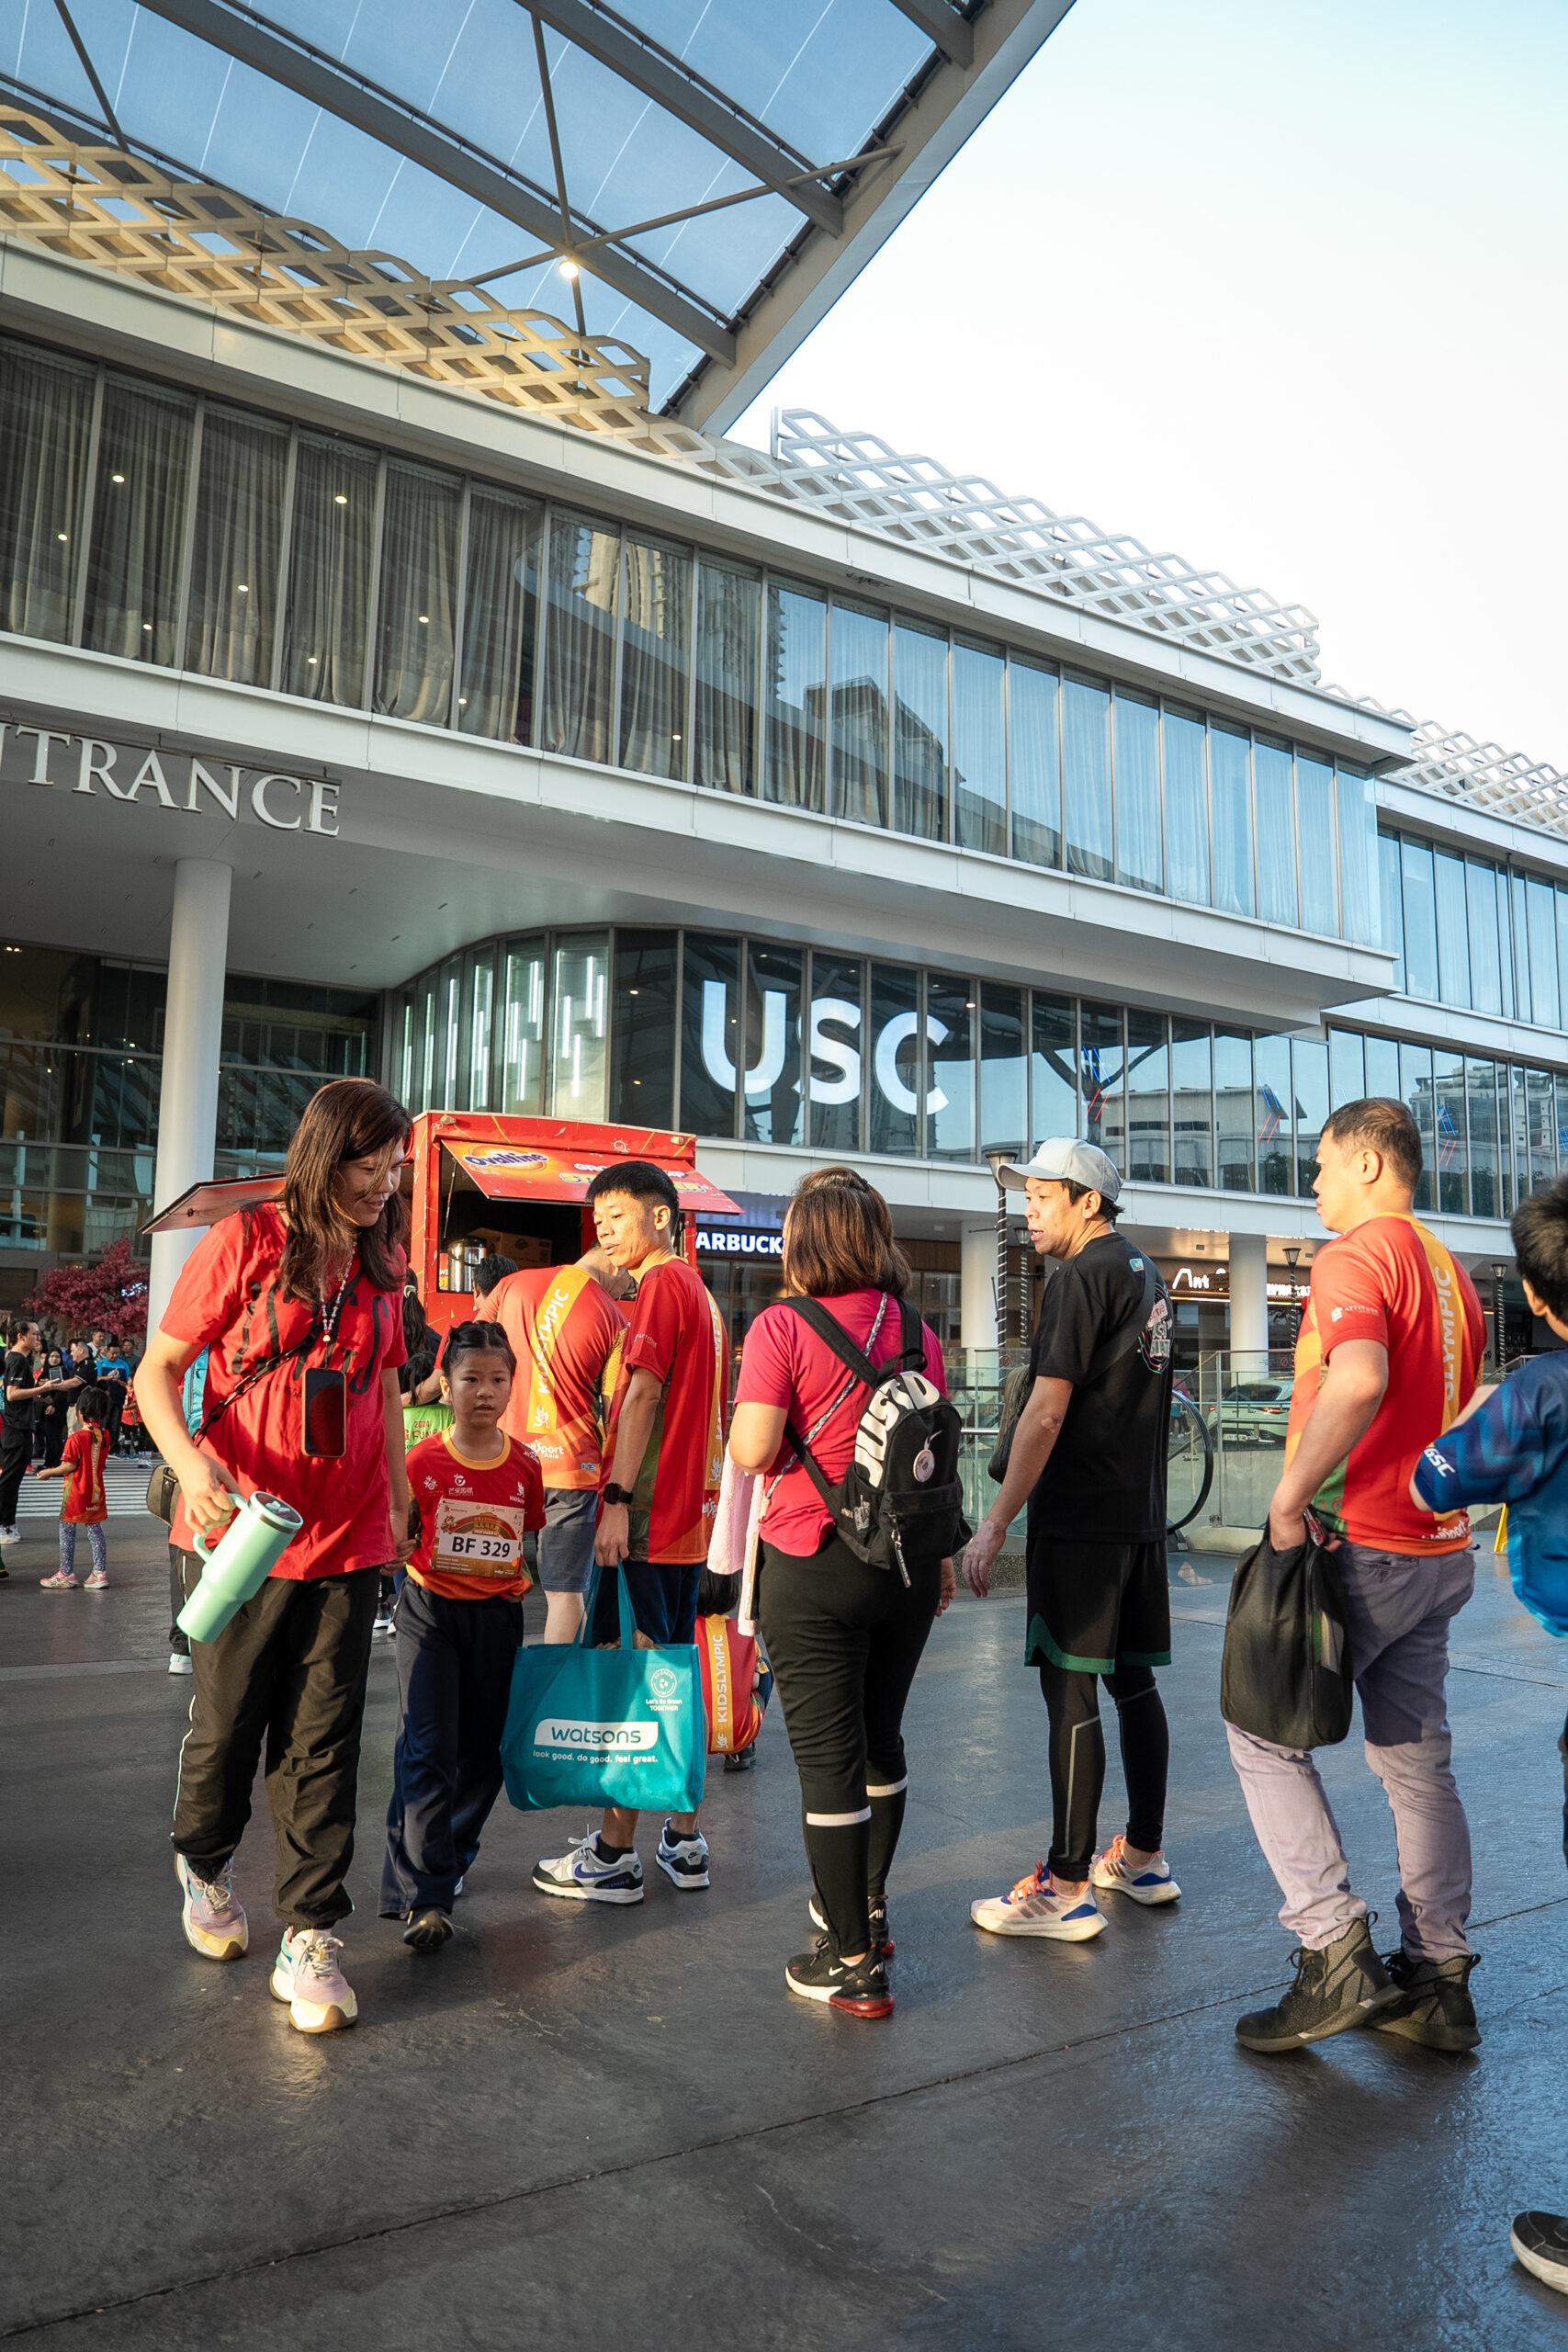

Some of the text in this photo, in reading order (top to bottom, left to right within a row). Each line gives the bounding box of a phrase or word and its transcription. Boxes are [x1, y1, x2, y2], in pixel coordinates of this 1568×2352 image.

[700, 979, 950, 1115] USC
[462, 1151, 549, 1167] Ovaltine
[696, 1231, 786, 1255] ARBUCK
[854, 1378, 915, 1488] JUST
[451, 1536, 511, 1558] BF 329
[713, 1634, 728, 1723] KIDSLYMPIC
[551, 1726, 642, 1744] watsons
[533, 1749, 550, 1758] look
[577, 1753, 588, 1762] do
[615, 1754, 631, 1763] feel
